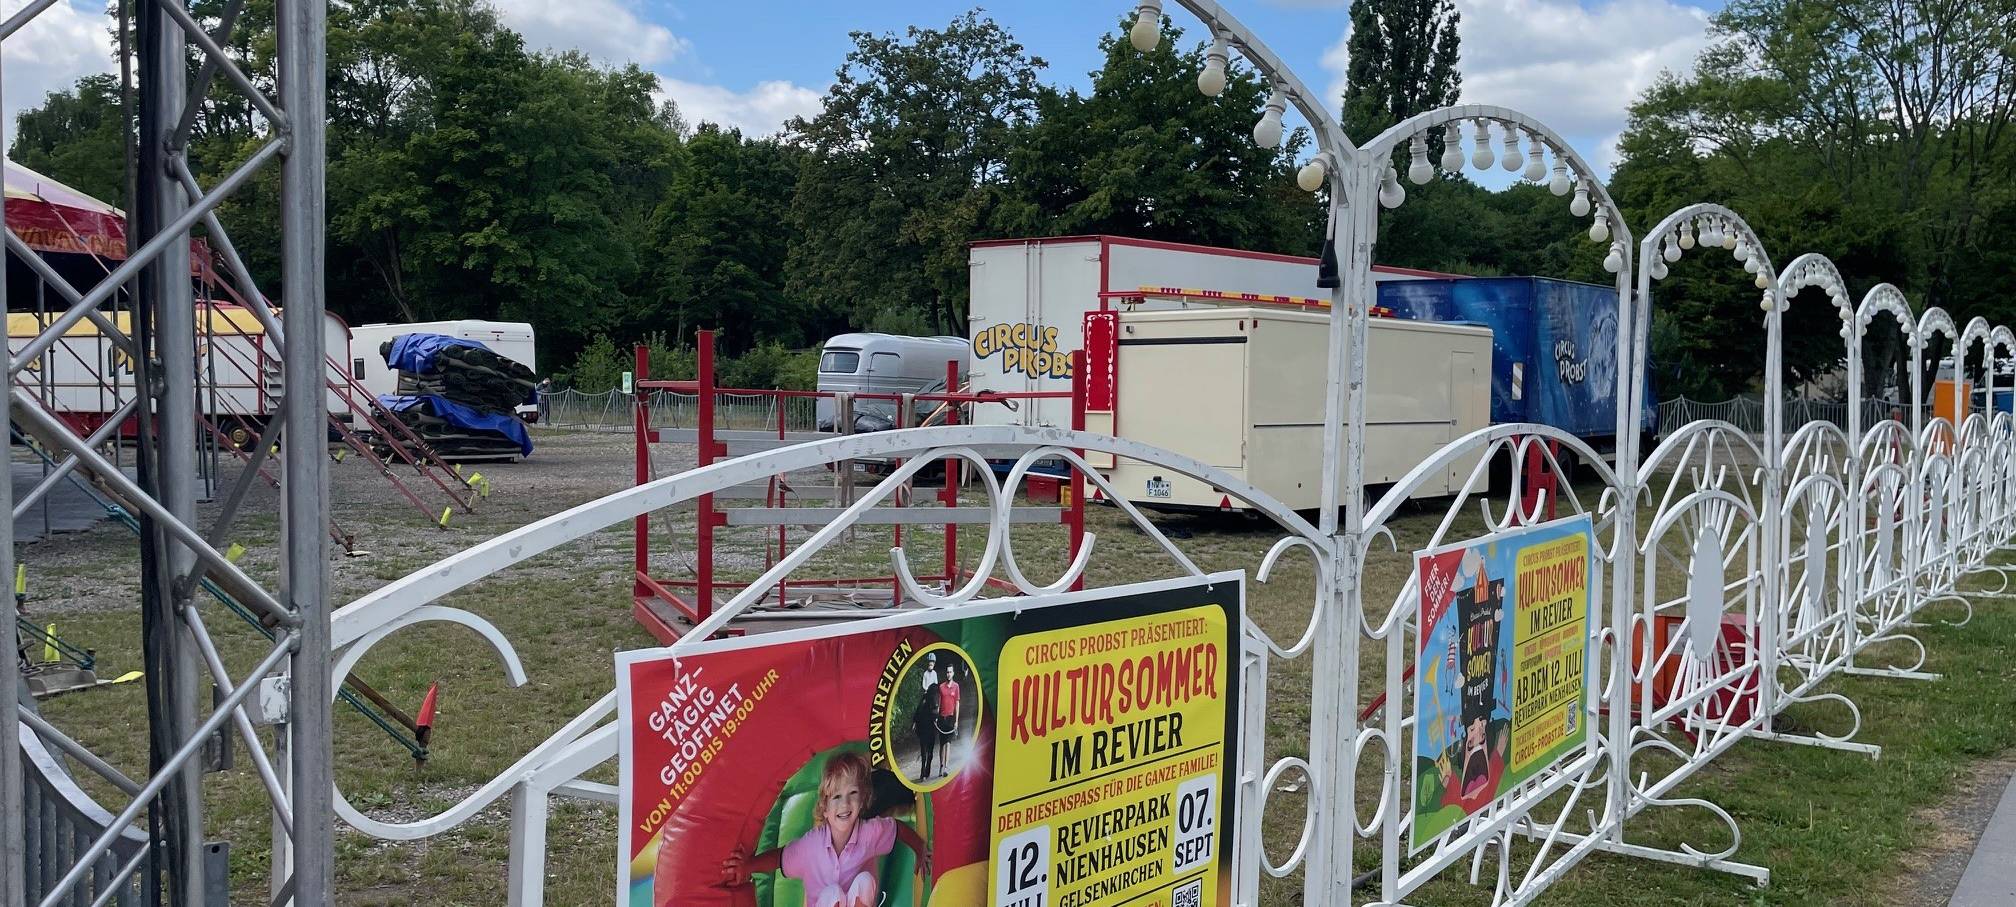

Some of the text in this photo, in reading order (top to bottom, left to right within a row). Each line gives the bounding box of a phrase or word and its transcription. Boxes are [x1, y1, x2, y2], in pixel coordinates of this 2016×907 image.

[974, 323, 1058, 359] CIRCUS
[1003, 347, 1073, 379] PROBS
[1555, 340, 1575, 360] CIRCUS
[1560, 358, 1588, 384] PROBST
[1424, 562, 1440, 597] FEIER
[1427, 572, 1451, 627] SOMMER!
[1430, 576, 1441, 602] DEN
[1518, 555, 1585, 611] KULTURSOMMER
[1025, 617, 1208, 666] CIRCUS PROBST PRÄSENTIERT:
[1467, 619, 1494, 656] KULTUR
[1530, 597, 1573, 635] IM REVIER
[1467, 651, 1492, 681] SOMMER
[1515, 676, 1529, 708] AB
[1531, 664, 1549, 698] DEM
[1551, 659, 1563, 688] 12.
[1564, 649, 1583, 682] JULI
[649, 667, 703, 732] GANZ-
[662, 686, 715, 747] TÄGIG
[870, 638, 913, 767] PONYREITEN
[1010, 643, 1218, 744] KULTURSOMMER
[1514, 677, 1582, 728] REVIERPARK NIENHAUSEN
[640, 668, 779, 834] VON 11:00 BIS 19:00 UHR
[660, 683, 743, 786] GEÖFFNET
[1050, 712, 1183, 782] IM REVIER
[1514, 724, 1565, 765] CIRCUS-PROBST.DE
[998, 752, 1218, 833] DER RIESENSPASS FÜR DIE GANZE FAMILIE!
[1178, 787, 1212, 834] 07.
[1057, 792, 1171, 857] REVIERPARK
[1174, 832, 1213, 868] SEPT
[1007, 841, 1047, 895] 12.
[1056, 826, 1169, 888] NIENHAUSEN
[1060, 858, 1164, 907] GELSENKIRCHEN
